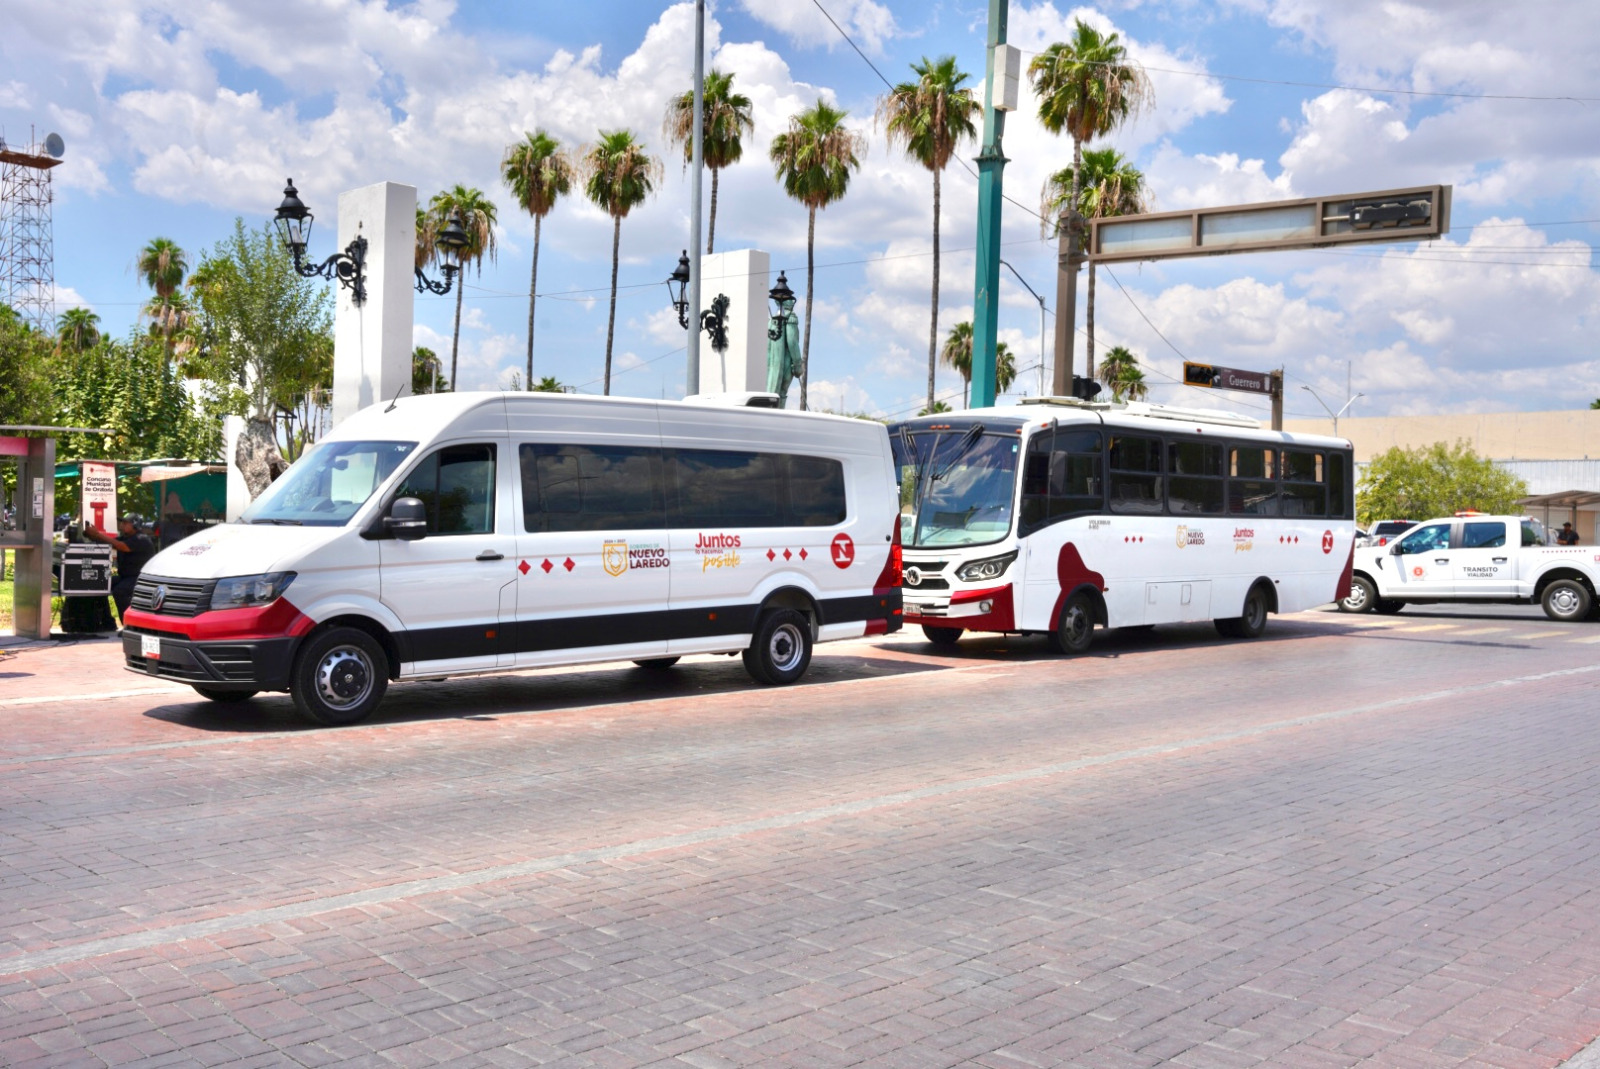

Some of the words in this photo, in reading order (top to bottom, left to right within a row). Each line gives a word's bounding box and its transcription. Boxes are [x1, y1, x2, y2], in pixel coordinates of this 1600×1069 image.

[1229, 374, 1261, 389] Guerrero
[1187, 531, 1204, 539] NUEVO
[1233, 527, 1254, 538] Juntos
[695, 532, 741, 549] Juntos
[629, 548, 665, 558] NUEVO
[629, 558, 671, 569] LAREDO
[702, 549, 741, 573] posible
